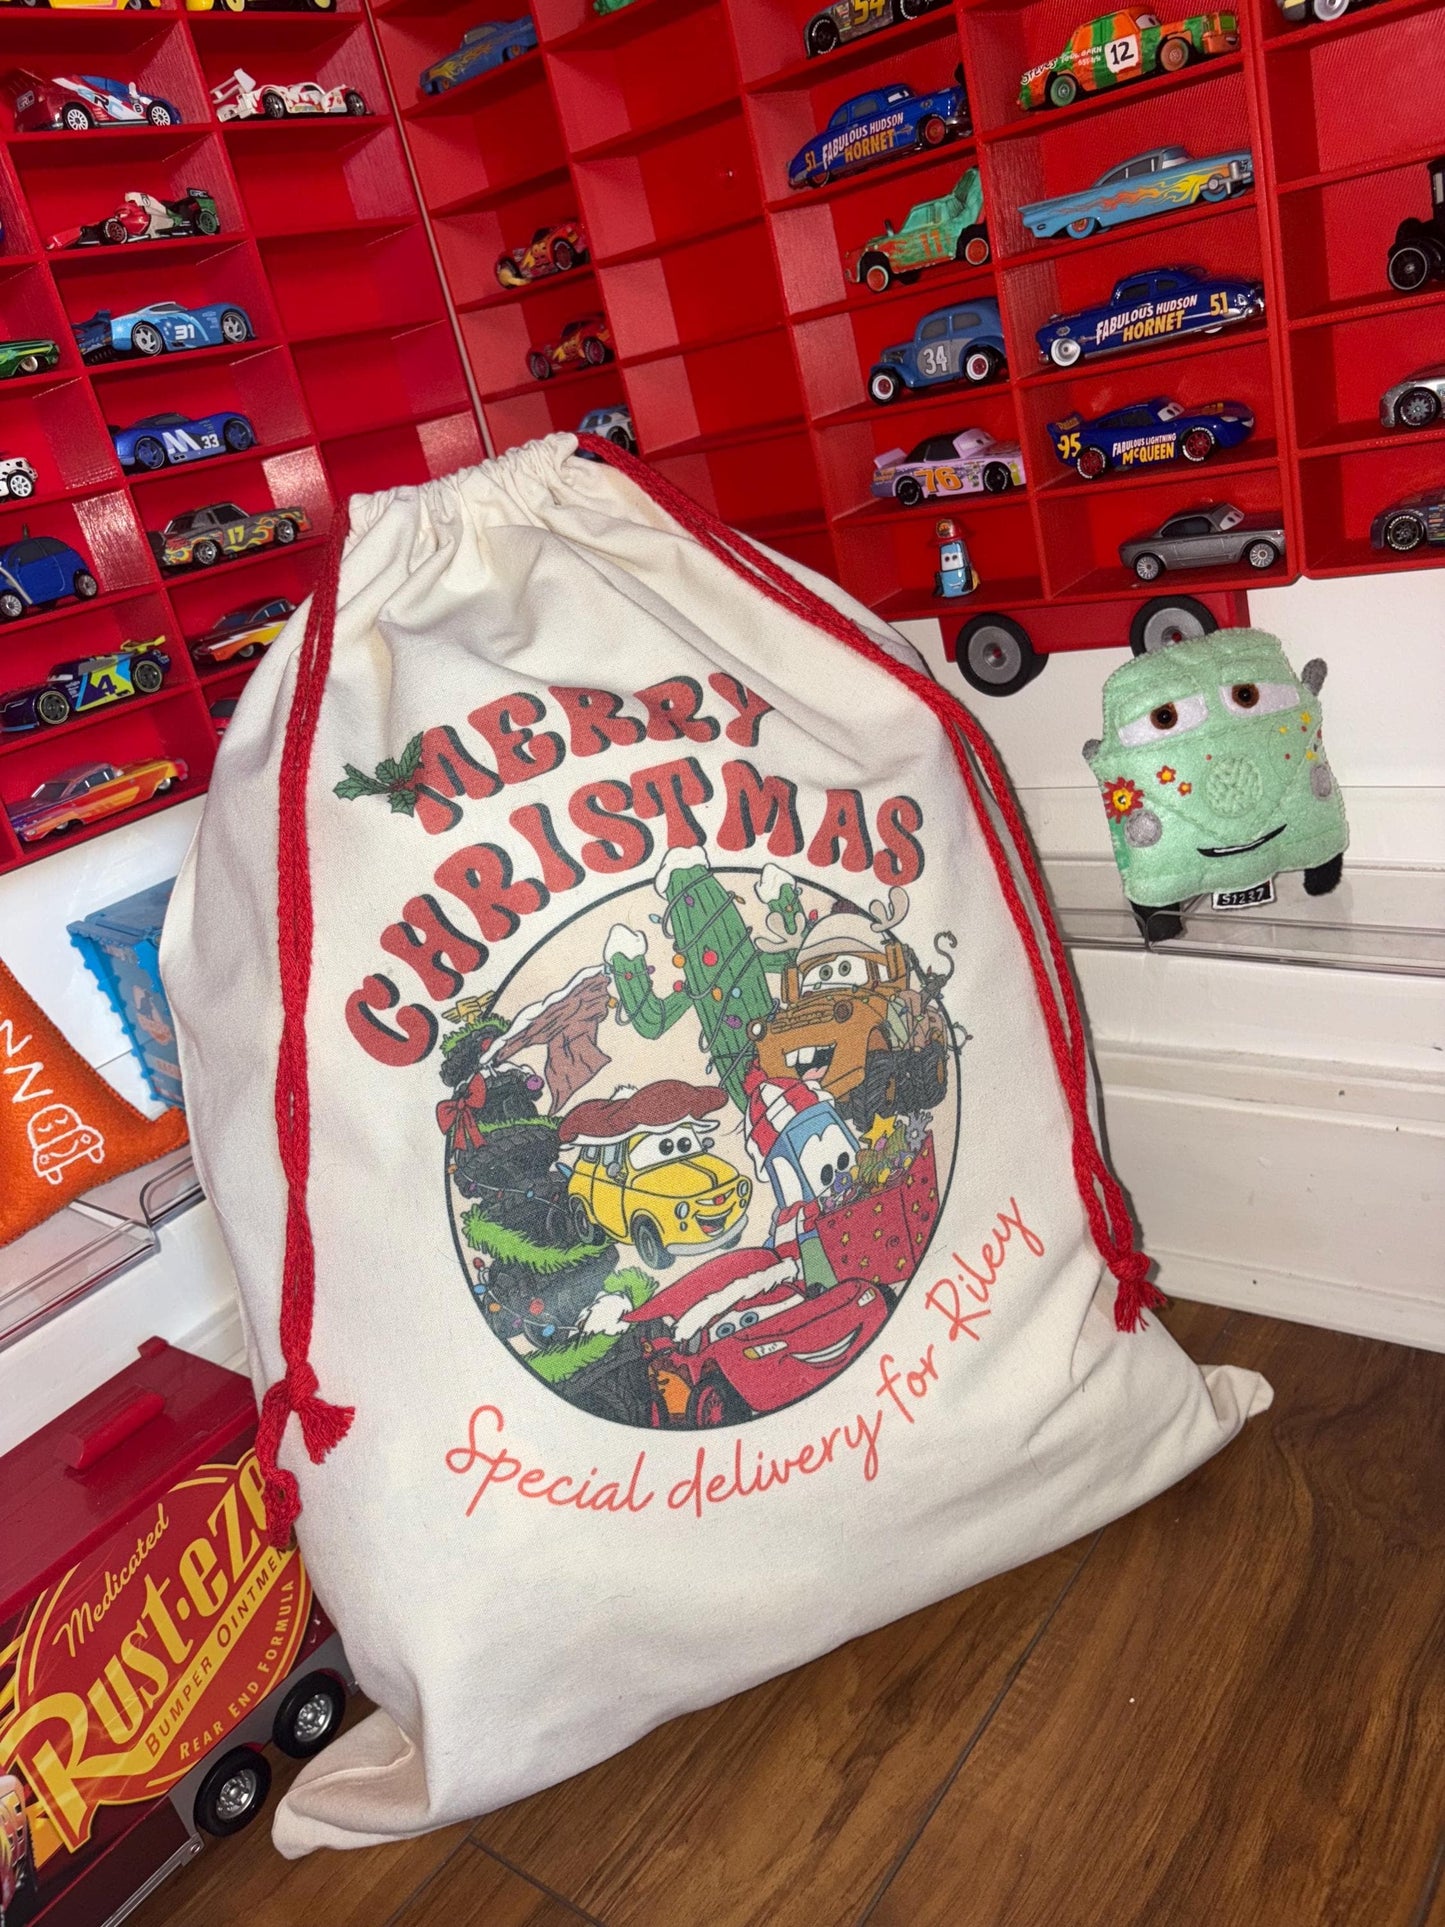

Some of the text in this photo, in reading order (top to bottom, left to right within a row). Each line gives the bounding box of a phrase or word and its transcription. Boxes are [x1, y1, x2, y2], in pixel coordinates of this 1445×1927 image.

[852, 0, 885, 25] 54
[1110, 41, 1135, 66] 12
[821, 112, 904, 171] FABULOUS HUDSON
[844, 129, 896, 163] HORNET
[805, 150, 817, 172] 51
[1210, 292, 1229, 316] 51
[175, 324, 195, 341] 31
[1096, 294, 1198, 345] FABULOUS HUDSON
[1122, 310, 1185, 342] HORNET
[923, 345, 948, 375] 34
[201, 434, 219, 449] 33
[1057, 432, 1082, 460] 95
[1112, 438, 1145, 458] FABULOUS
[1145, 433, 1177, 446] LIGHTNING
[914, 466, 965, 493] 76
[226, 525, 245, 545] 17
[97, 674, 117, 695] 4
[414, 672, 777, 835] MERRY
[345, 756, 925, 1067] CHRISTMAS
[445, 1197, 1046, 1518] Special delivery for Riley
[52, 1502, 169, 1658] Medicated
[179, 1580, 294, 1761] REAR END FORMULA
[144, 1655, 213, 1758] BUMPER
